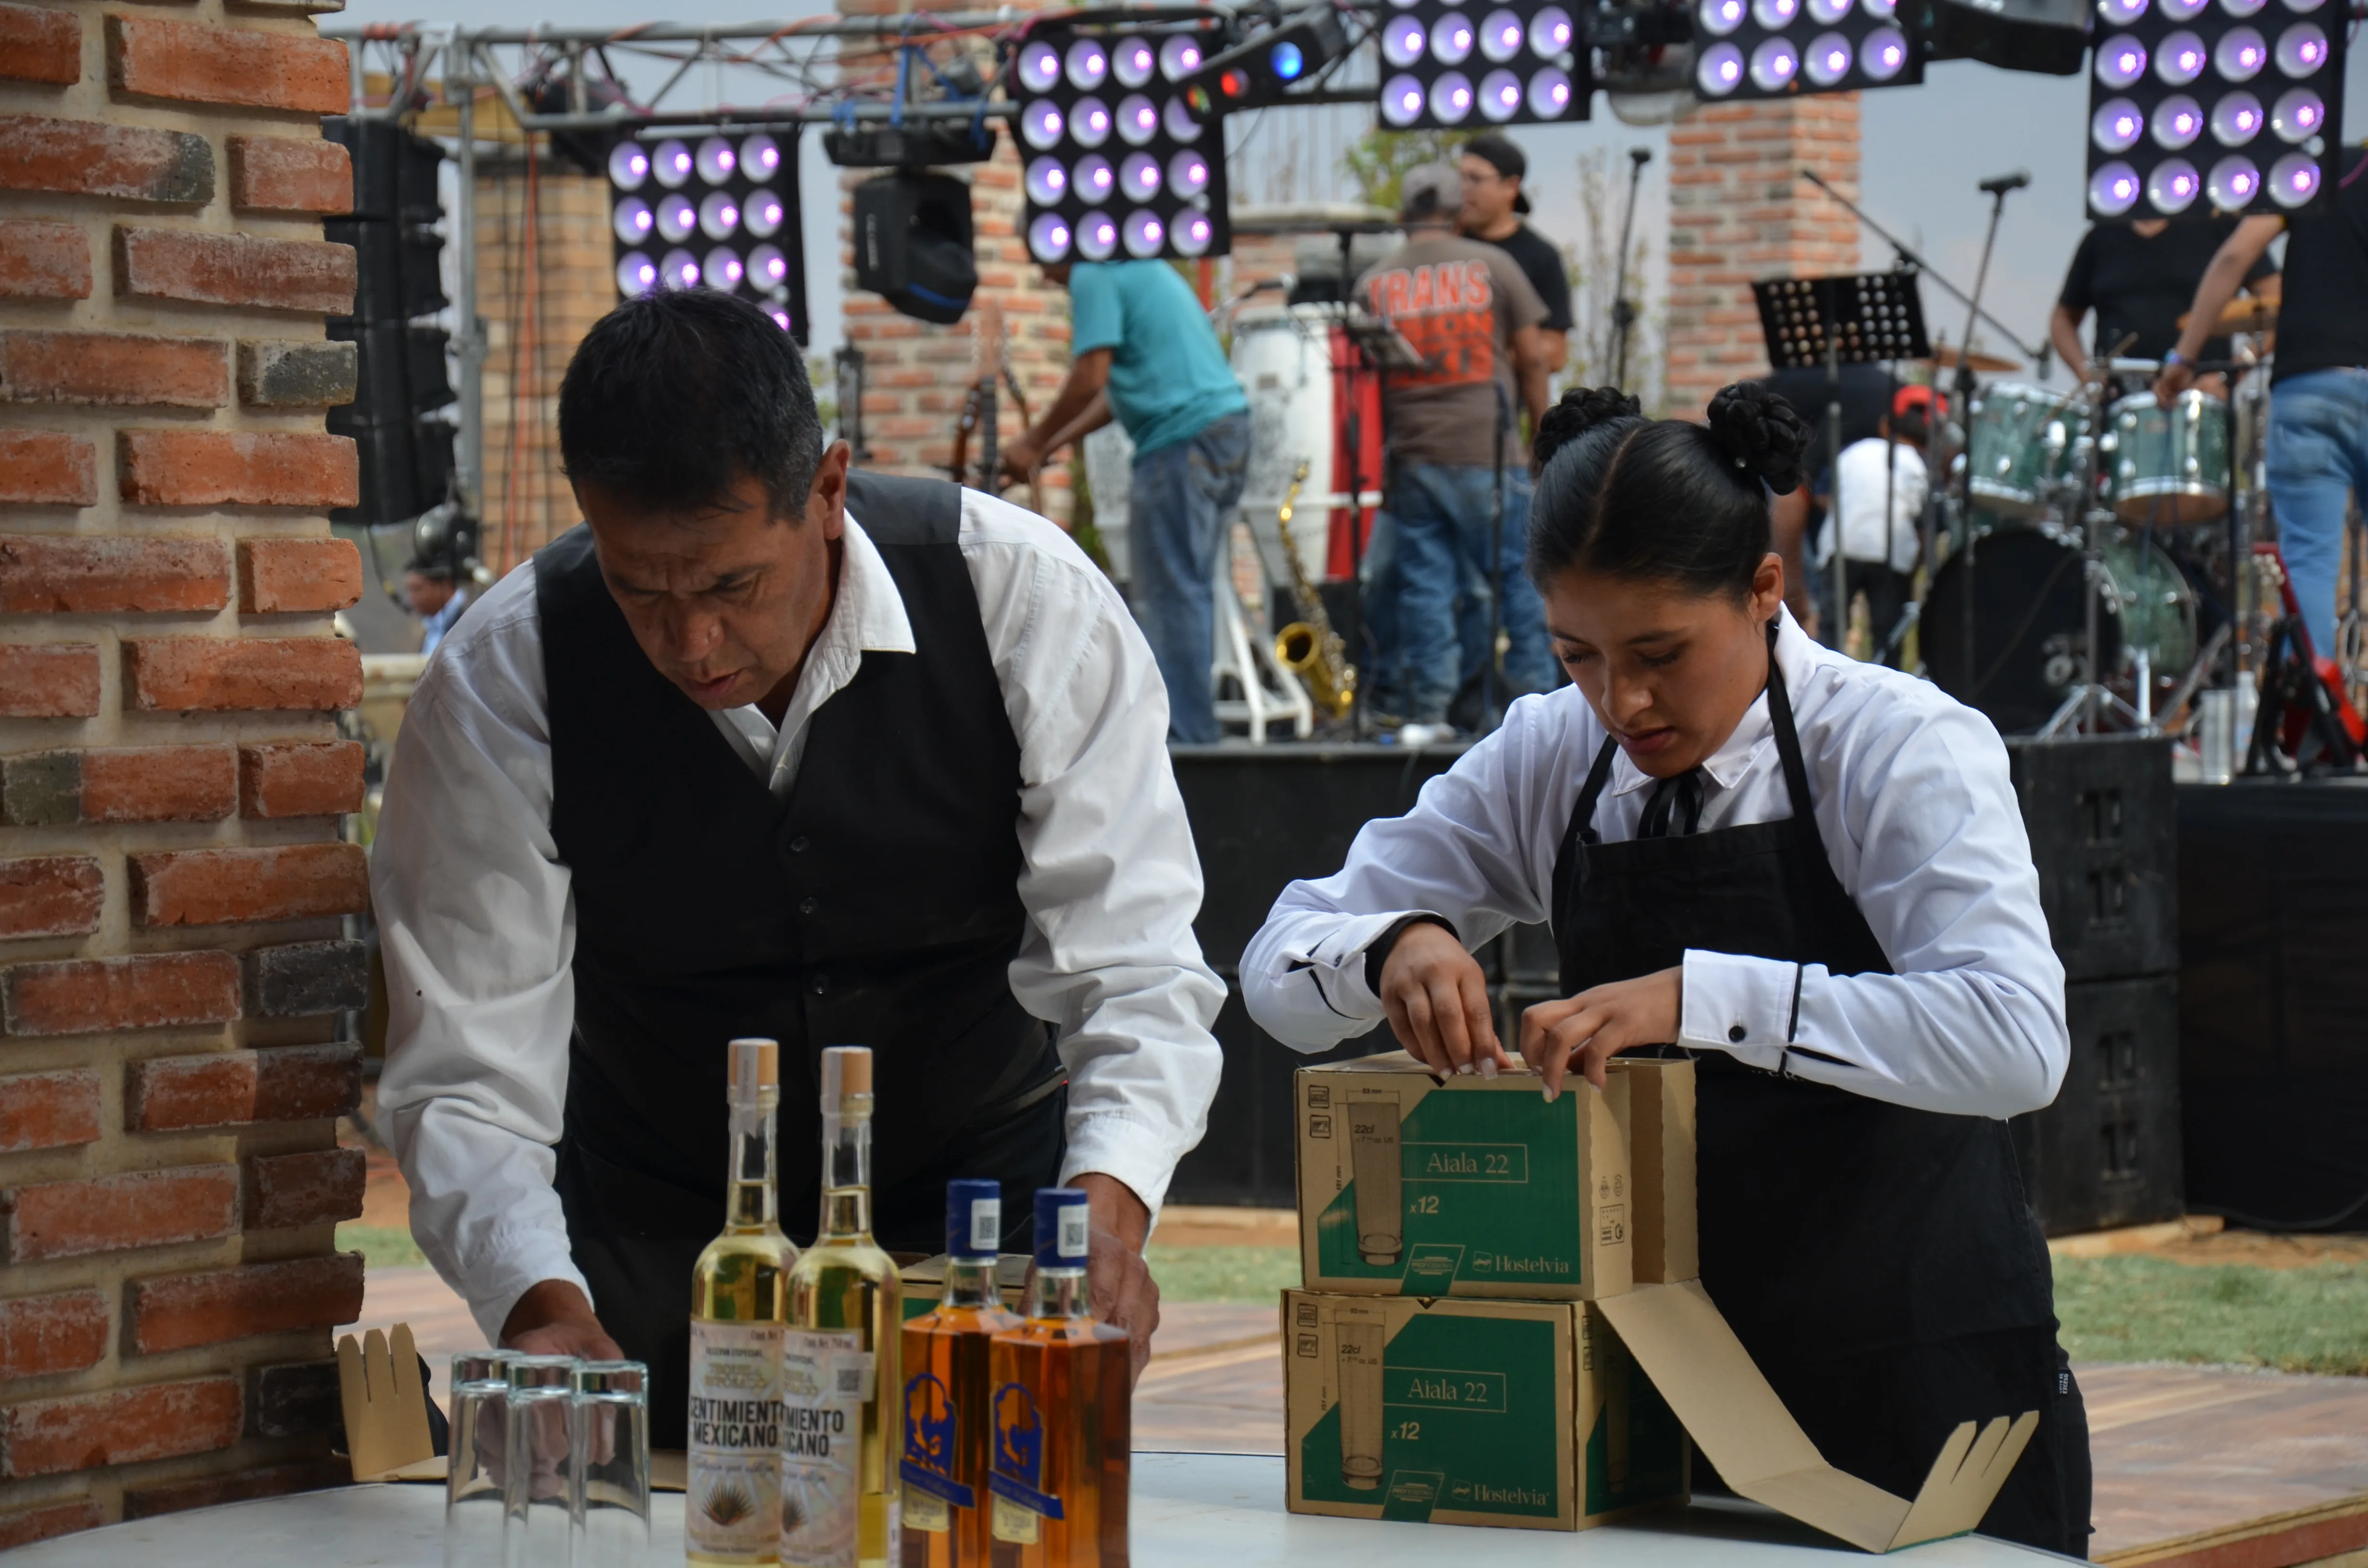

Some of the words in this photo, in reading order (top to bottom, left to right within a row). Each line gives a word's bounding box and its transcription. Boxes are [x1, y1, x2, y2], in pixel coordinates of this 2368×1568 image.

[1364, 259, 1492, 316] TRANS
[1354, 1124, 1375, 1134] 22cl
[1426, 1152, 1478, 1173] Aiala
[1485, 1154, 1509, 1173] 22
[1495, 1255, 1569, 1273] Hostelvia
[1341, 1345, 1361, 1354] 22cl
[1407, 1378, 1458, 1400] Aiala
[1465, 1382, 1487, 1402] 22
[1474, 1483, 1546, 1506] Hostelvia
